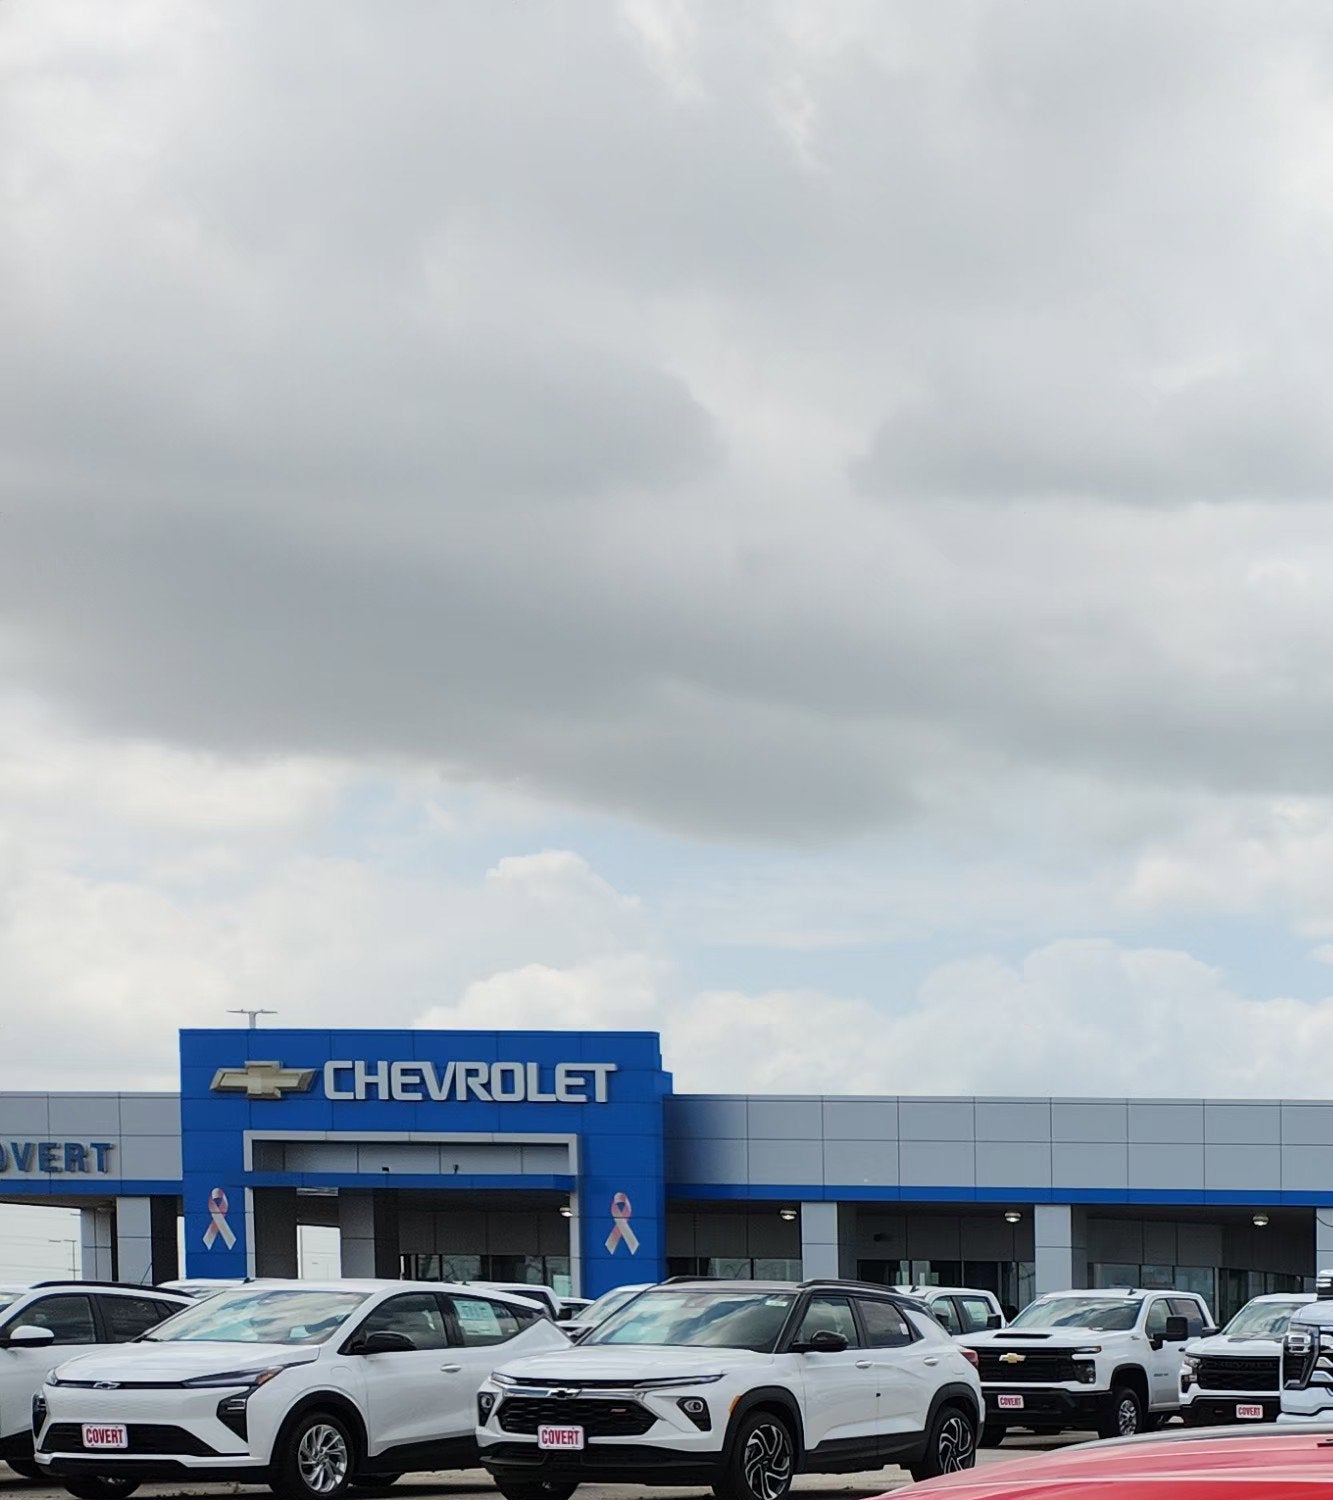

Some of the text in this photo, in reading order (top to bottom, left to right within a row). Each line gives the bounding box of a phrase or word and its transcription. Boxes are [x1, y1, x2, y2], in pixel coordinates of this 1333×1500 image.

[323, 1060, 618, 1103] CHEVROLET
[0, 1142, 114, 1173] VERT
[999, 1397, 1022, 1406] COVERT
[1238, 1407, 1261, 1416] COVERT
[86, 1428, 124, 1444] COVERT
[541, 1429, 580, 1445] COVERT
